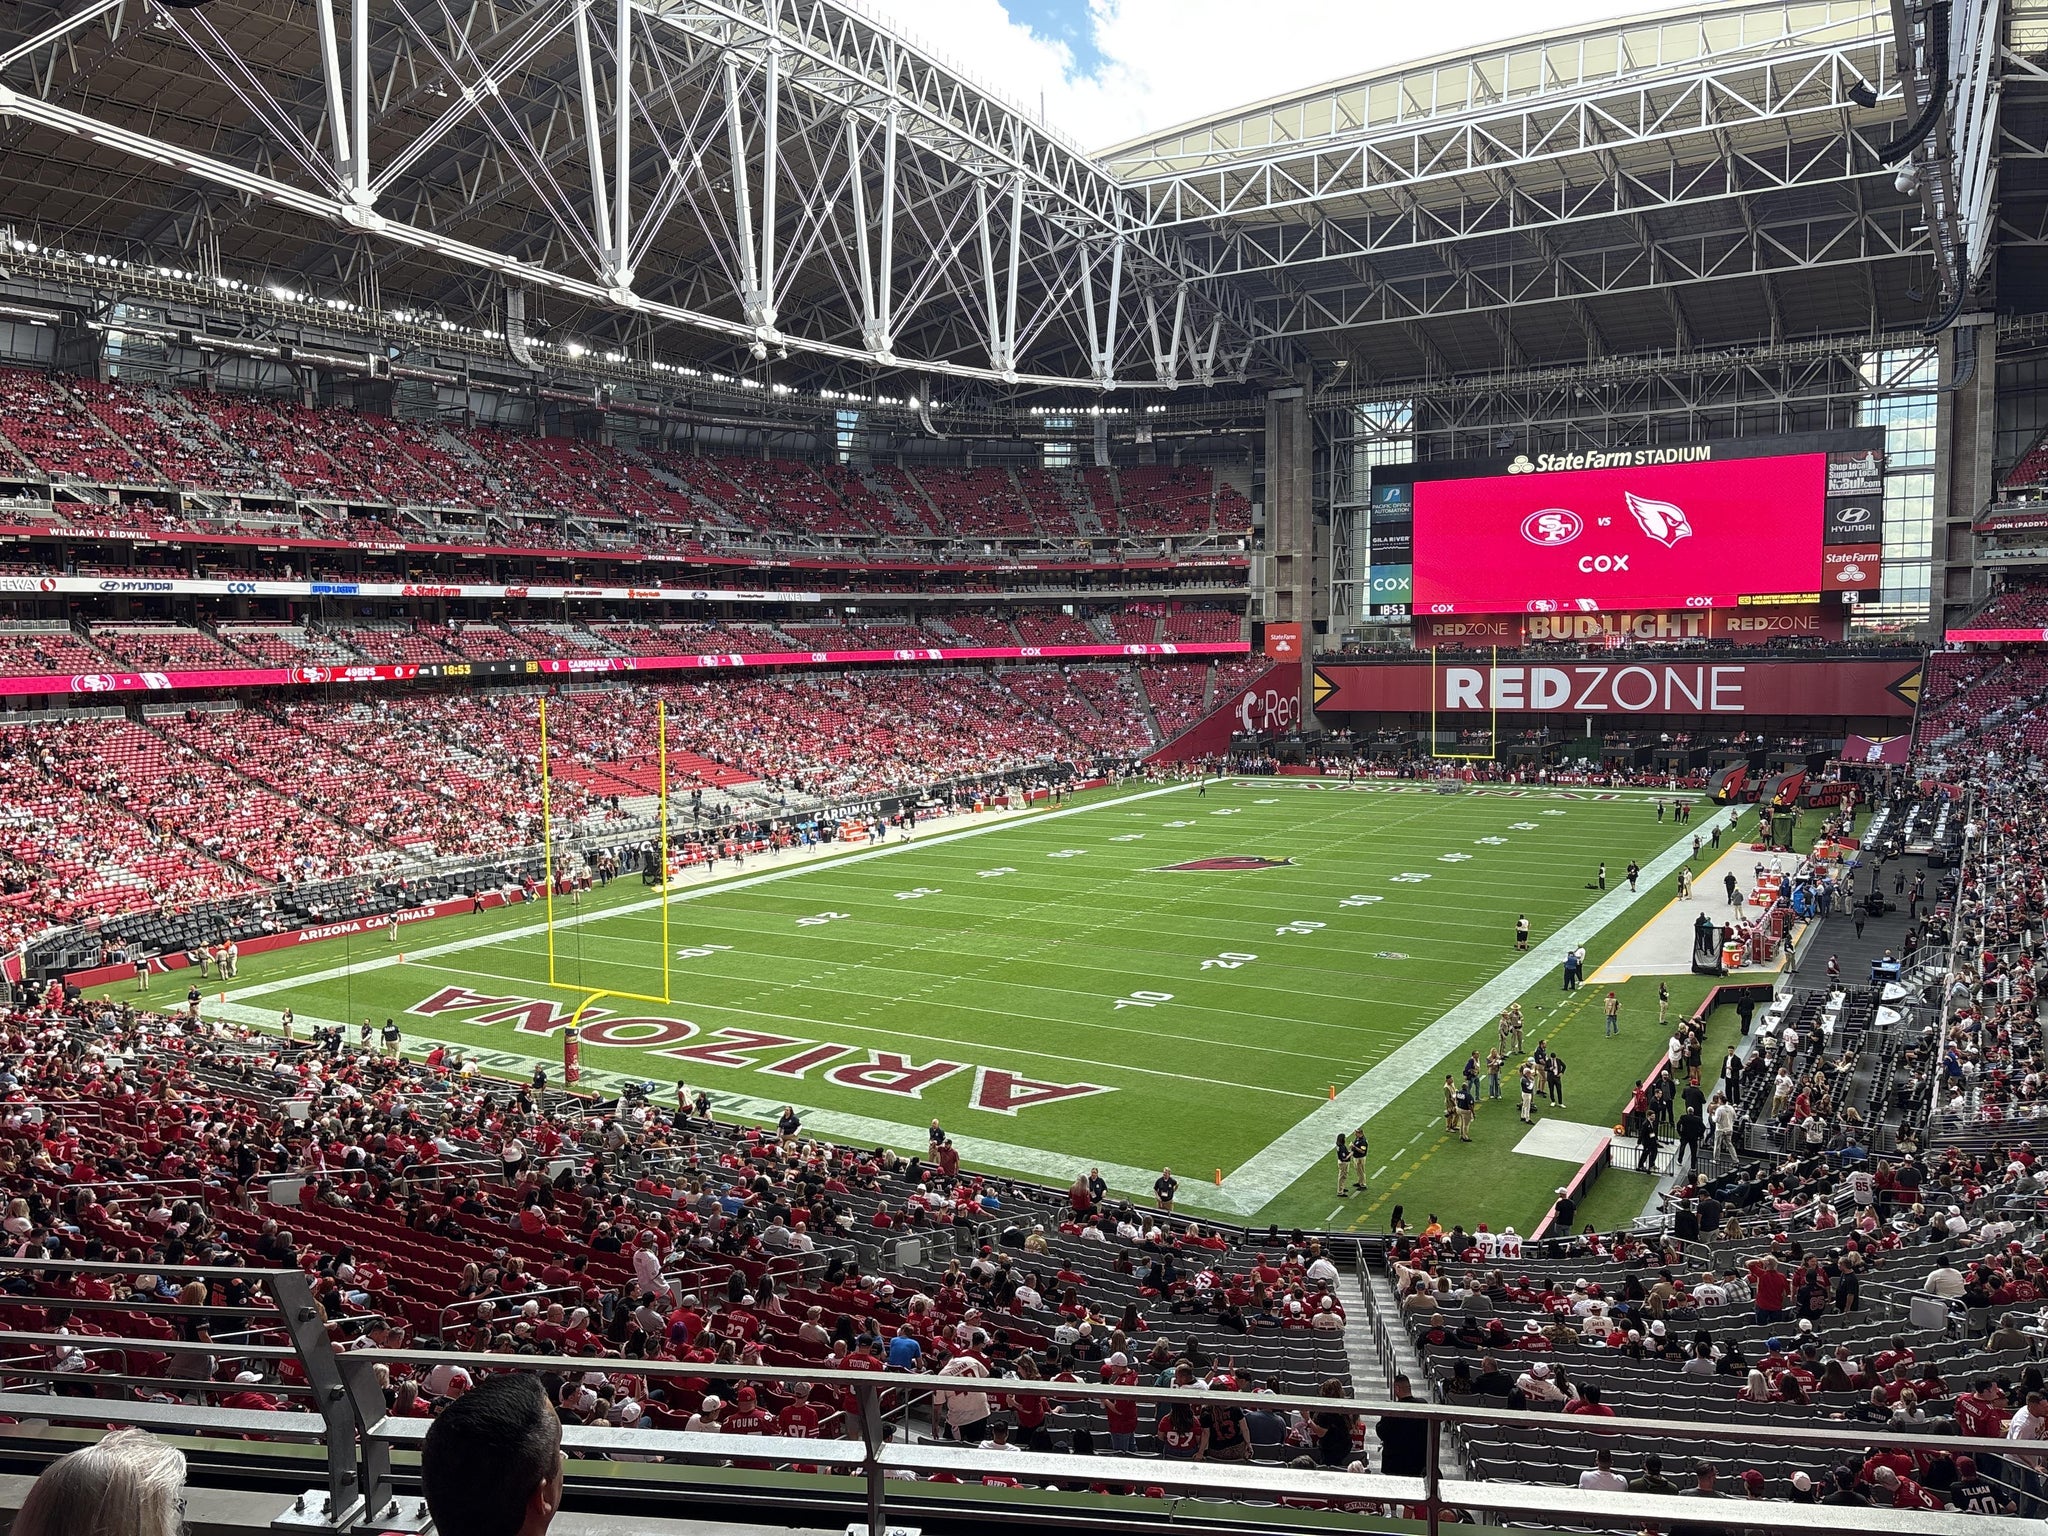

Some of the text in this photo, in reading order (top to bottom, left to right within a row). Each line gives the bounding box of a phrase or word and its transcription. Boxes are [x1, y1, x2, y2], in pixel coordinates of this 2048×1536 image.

[1634, 446, 1711, 466] STADIUM
[1829, 462, 1867, 472] Shop Local
[1829, 468, 1878, 478] Support Local
[1831, 523, 1875, 533] HYUNDAI
[1992, 522, 2013, 530] JOHN
[49, 527, 151, 539] WILLIAM V. BIDWILL
[358, 541, 373, 549] PAT
[374, 542, 406, 550] TILLMAN
[1578, 554, 1629, 573] COX
[121, 582, 174, 591] HYUNDAI
[227, 582, 257, 593] COX
[311, 584, 358, 594] BUD LIGHT
[1374, 577, 1410, 591] COX
[1686, 597, 1713, 607] COX
[1843, 591, 1858, 603] 25
[1380, 604, 1405, 615] 18:53
[1431, 604, 1454, 613] COX
[1432, 622, 1509, 636] REDZONE
[1528, 613, 1704, 639] BUD LIGHT
[1727, 616, 1820, 631] REDZONE
[811, 652, 827, 662] COX
[1020, 648, 1041, 656] COX
[442, 664, 471, 676] 18:53
[568, 659, 609, 669] CARDINALS
[345, 667, 376, 677] 49ERS
[1446, 666, 1745, 711] REDZONE
[1264, 687, 1301, 729] Red
[814, 801, 881, 821] CARDINALS
[1339, 895, 1384, 906] 40
[298, 907, 436, 942] ARIZONA CARINALS
[1276, 921, 1327, 934] 30
[1200, 952, 1258, 968] 20
[1732, 952, 1740, 962] G
[1115, 991, 1174, 1009] 10
[403, 985, 1121, 1117] ARIZONA
[1855, 1181, 1869, 1192] 85
[1480, 1243, 1493, 1255] 97
[1501, 1243, 1520, 1258] 44
[727, 1323, 745, 1339] 23
[848, 1359, 870, 1369] YOUNG
[950, 1362, 968, 1376] TILLMAN
[732, 1417, 759, 1429] YOUNG
[788, 1425, 807, 1438] 97
[1167, 1431, 1193, 1448] 97
[1962, 1485, 1991, 1496] TILLMAN
[1968, 1496, 1997, 1514] 40
